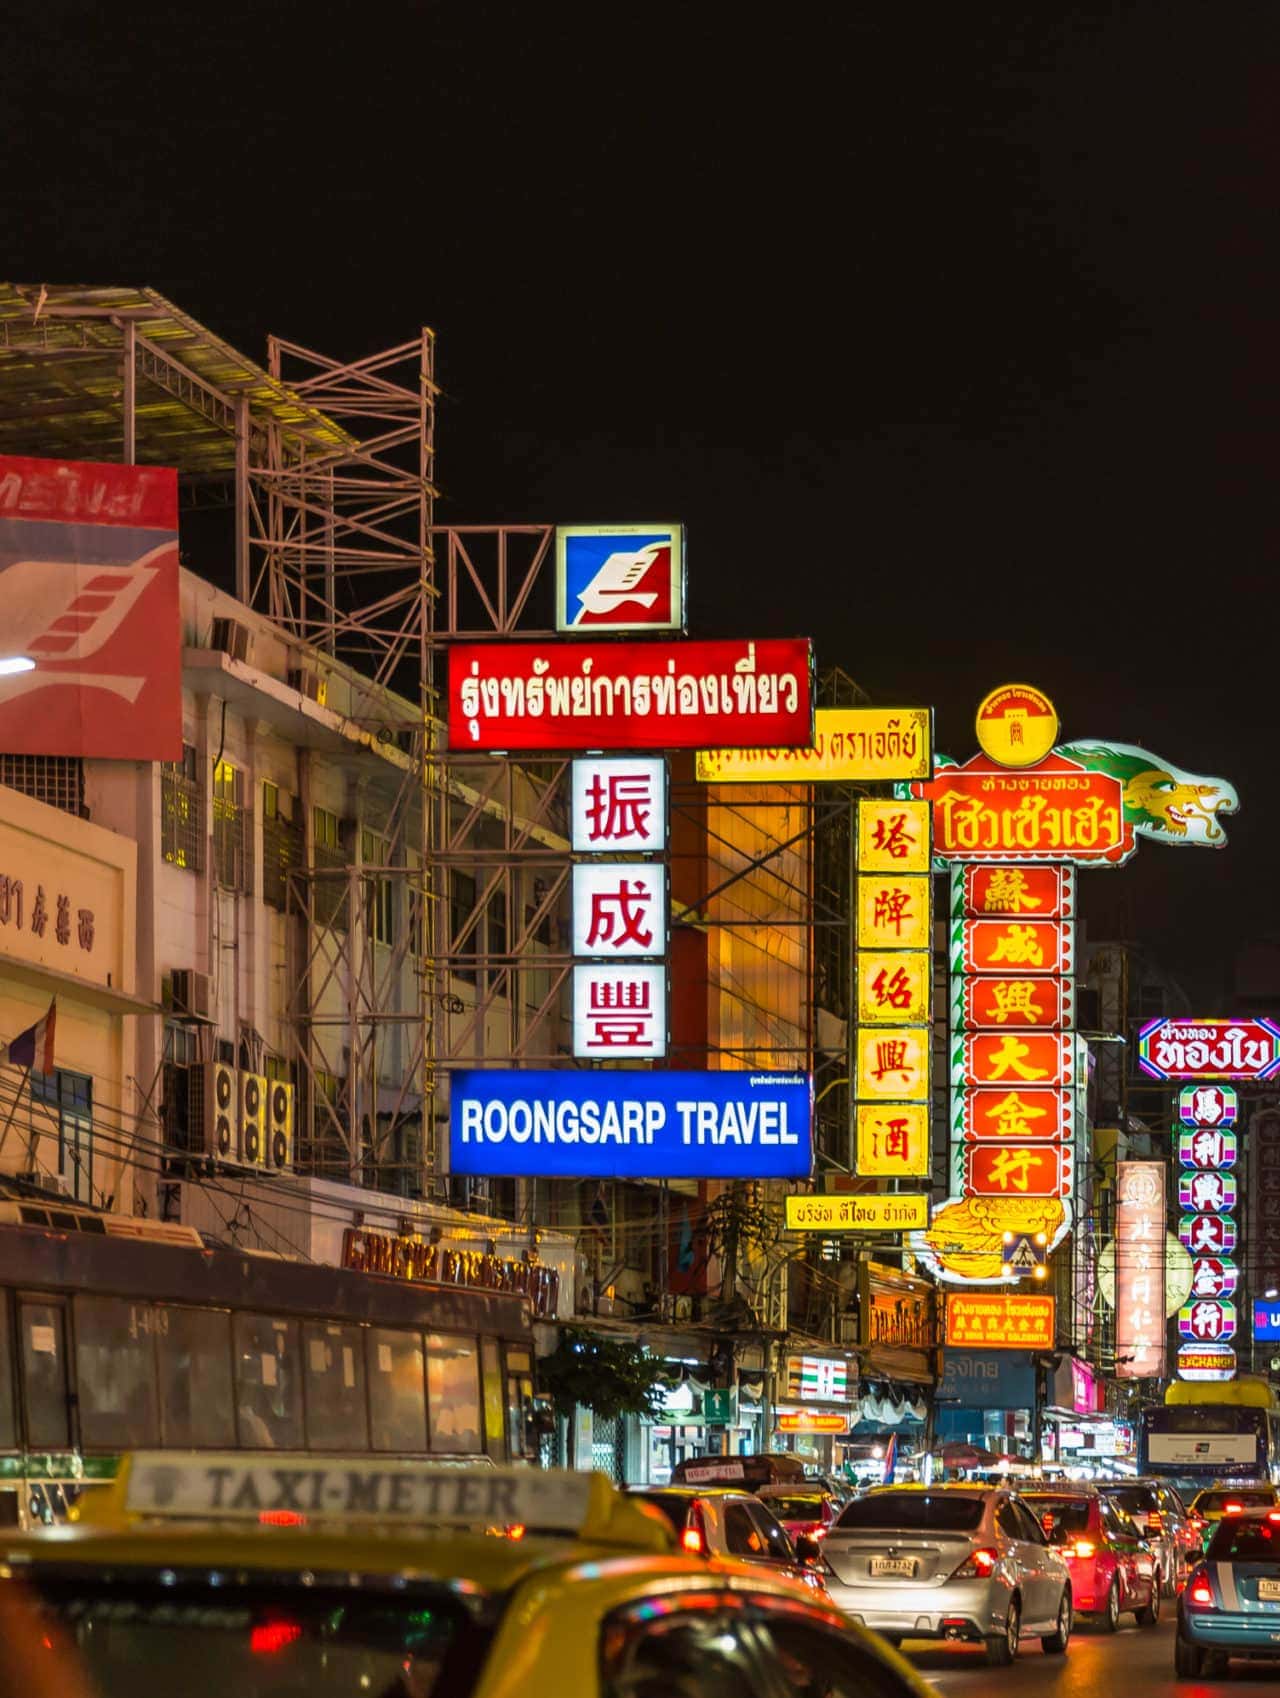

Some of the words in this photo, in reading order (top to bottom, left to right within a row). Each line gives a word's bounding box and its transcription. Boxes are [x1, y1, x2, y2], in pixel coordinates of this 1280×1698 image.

[585, 774, 654, 1047] 振成豐
[871, 814, 916, 1162] 塔牌紹興酒
[462, 1100, 666, 1144] ROONGSARP
[676, 1101, 799, 1145] TRAVEL
[205, 1467, 521, 1517] TAXI-METER
